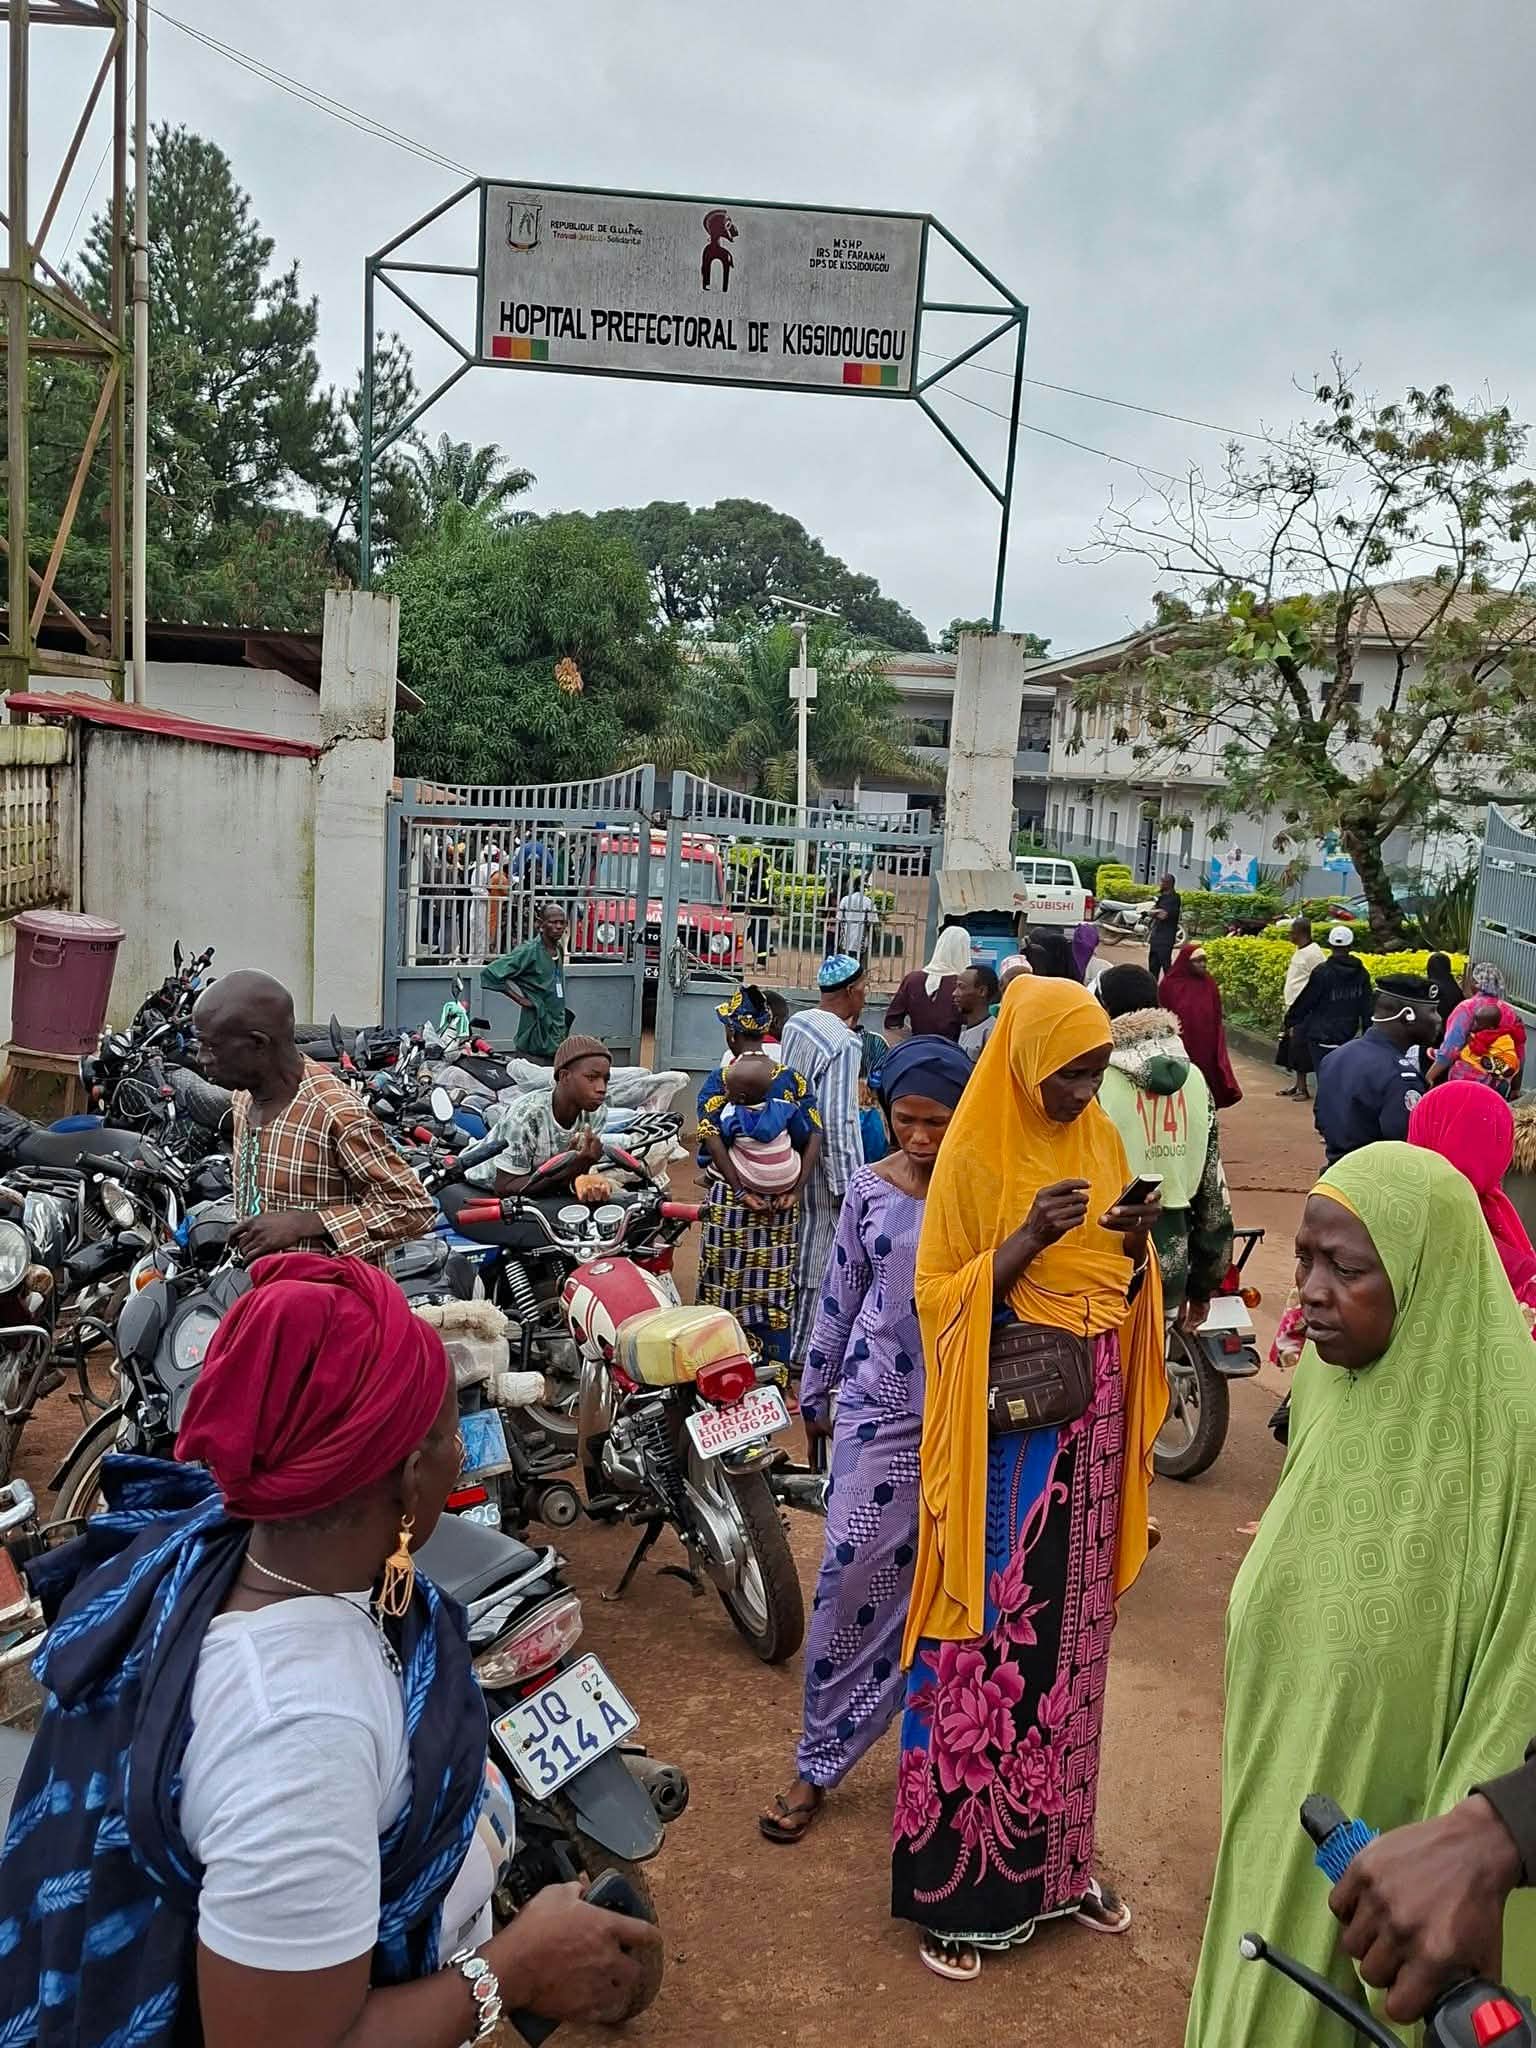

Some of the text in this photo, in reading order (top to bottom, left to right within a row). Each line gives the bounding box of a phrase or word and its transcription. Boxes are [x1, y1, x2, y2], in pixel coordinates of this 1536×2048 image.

[597, 224, 607, 233] DE
[833, 238, 863, 249] MSHP
[816, 247, 886, 262] IRS DE FARANAH
[809, 258, 890, 272] DPS DE KISSIDOUGOU
[500, 301, 907, 361] HOPITAL PREFECTORAL DE KISSIDOUGOU
[1030, 900, 1074, 911] SUBISHI
[698, 1401, 774, 1438] HORIZON
[522, 1690, 572, 1744] JQ
[528, 1700, 628, 1786] 314 A
